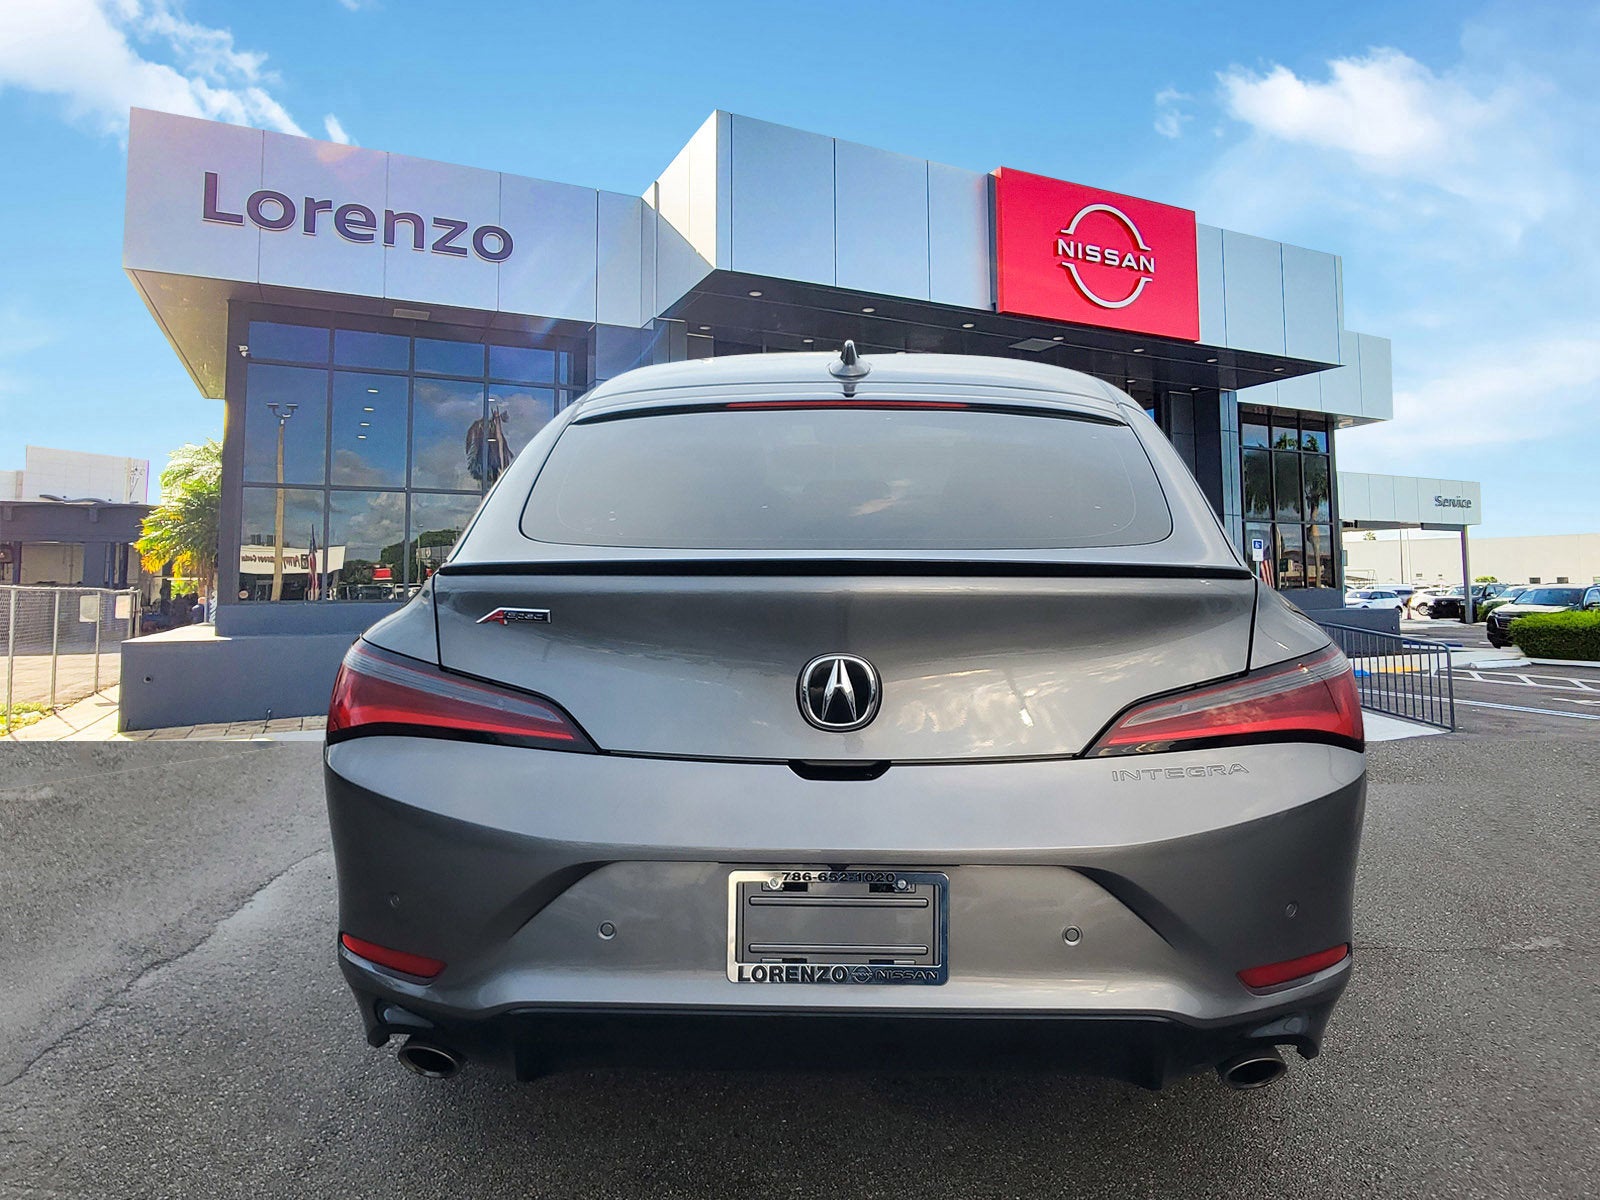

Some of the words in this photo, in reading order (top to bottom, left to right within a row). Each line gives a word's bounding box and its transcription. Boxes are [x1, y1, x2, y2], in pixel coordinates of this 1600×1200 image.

[202, 171, 514, 262] Lorenzo
[1057, 238, 1155, 273] NISSAN
[1434, 495, 1472, 508] Service
[1111, 763, 1250, 782] INTEGRA
[781, 872, 896, 882] 786-652-1020
[737, 965, 849, 983] LORENZO
[875, 970, 939, 981] NISSAN
